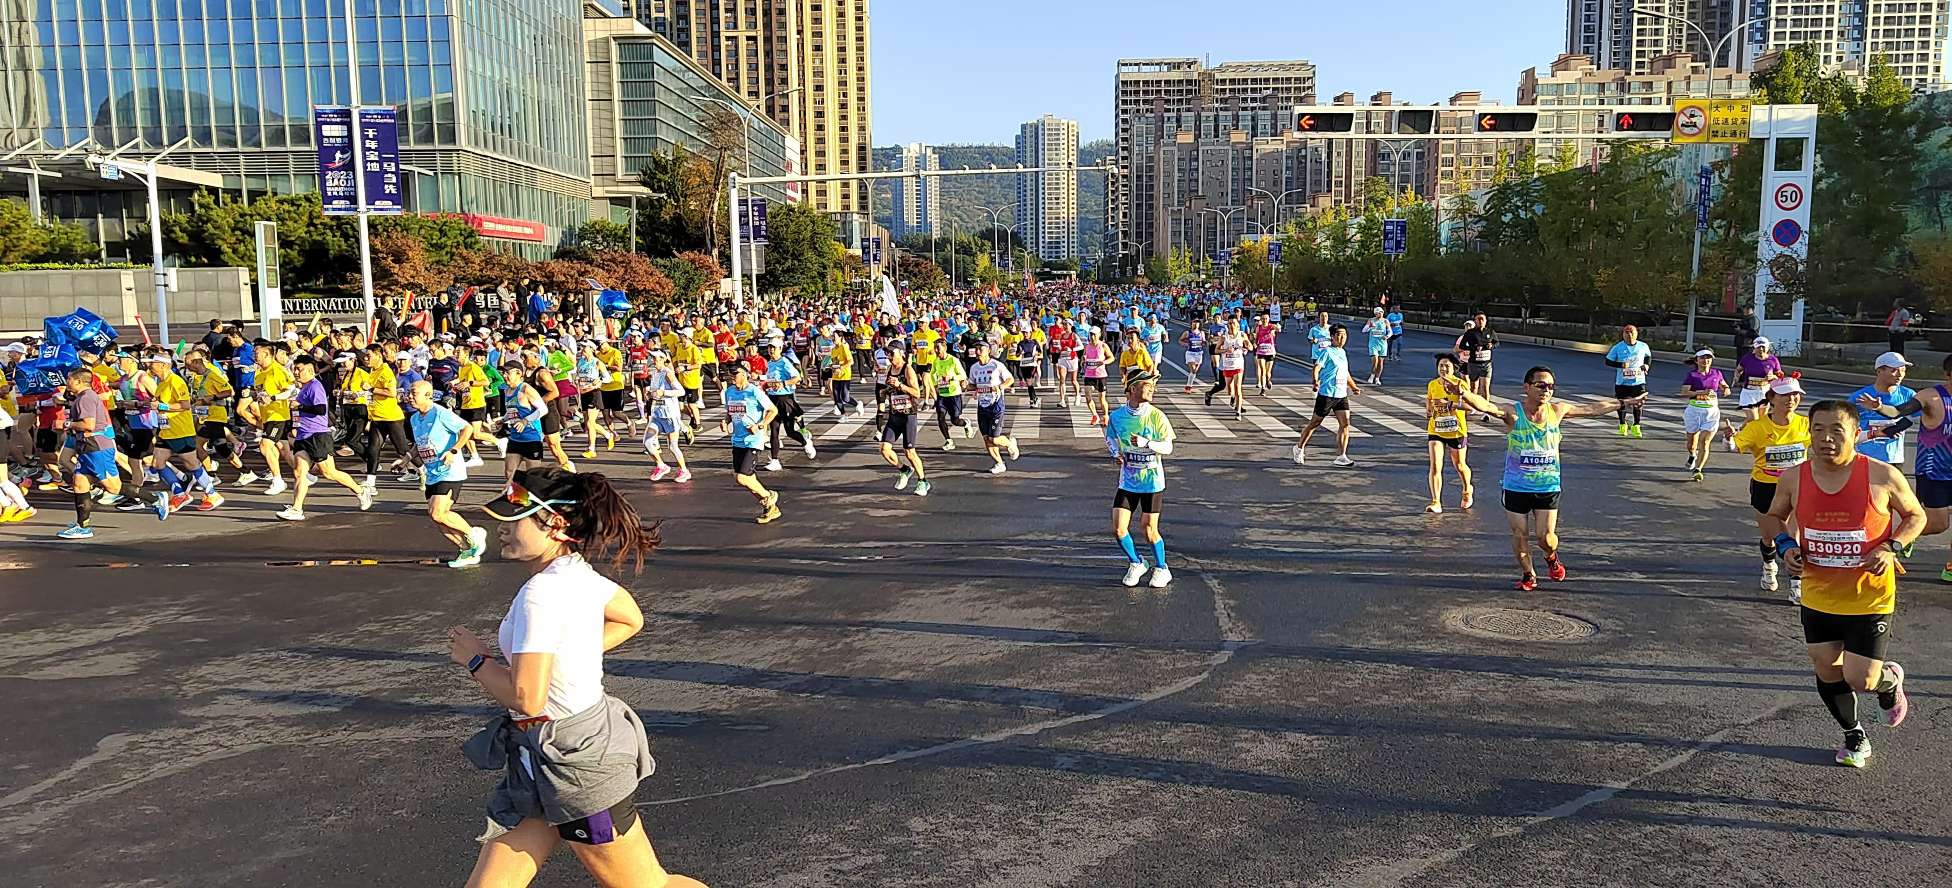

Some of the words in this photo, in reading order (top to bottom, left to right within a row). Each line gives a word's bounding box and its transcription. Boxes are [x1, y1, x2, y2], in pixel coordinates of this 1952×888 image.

[1711, 130, 1747, 138] 禁止通行
[325, 171, 353, 179] 2023
[326, 179, 355, 187] BAOJI
[1780, 190, 1798, 203] 50
[1808, 541, 1861, 554] B30920
